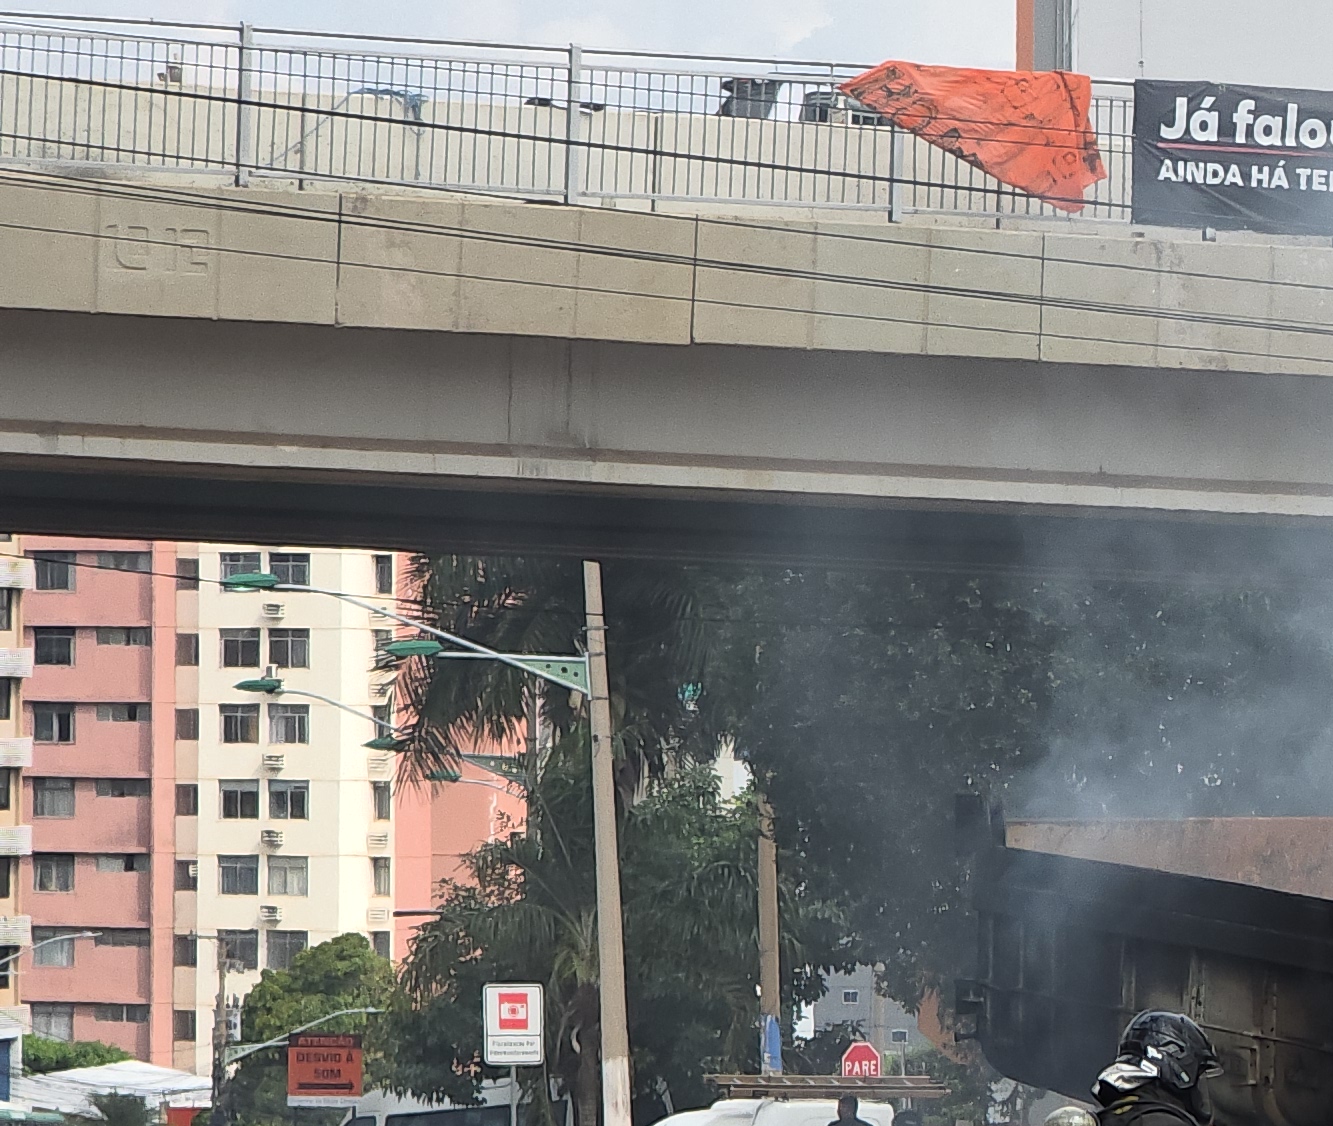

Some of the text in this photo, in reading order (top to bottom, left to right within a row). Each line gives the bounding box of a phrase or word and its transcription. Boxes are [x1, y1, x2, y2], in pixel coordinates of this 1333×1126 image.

[1159, 96, 1220, 141] Já
[1157, 159, 1244, 187] AINDA
[1250, 160, 1290, 189] HÁ
[296, 1052, 341, 1063] DESVIO
[845, 1060, 877, 1076] PARE
